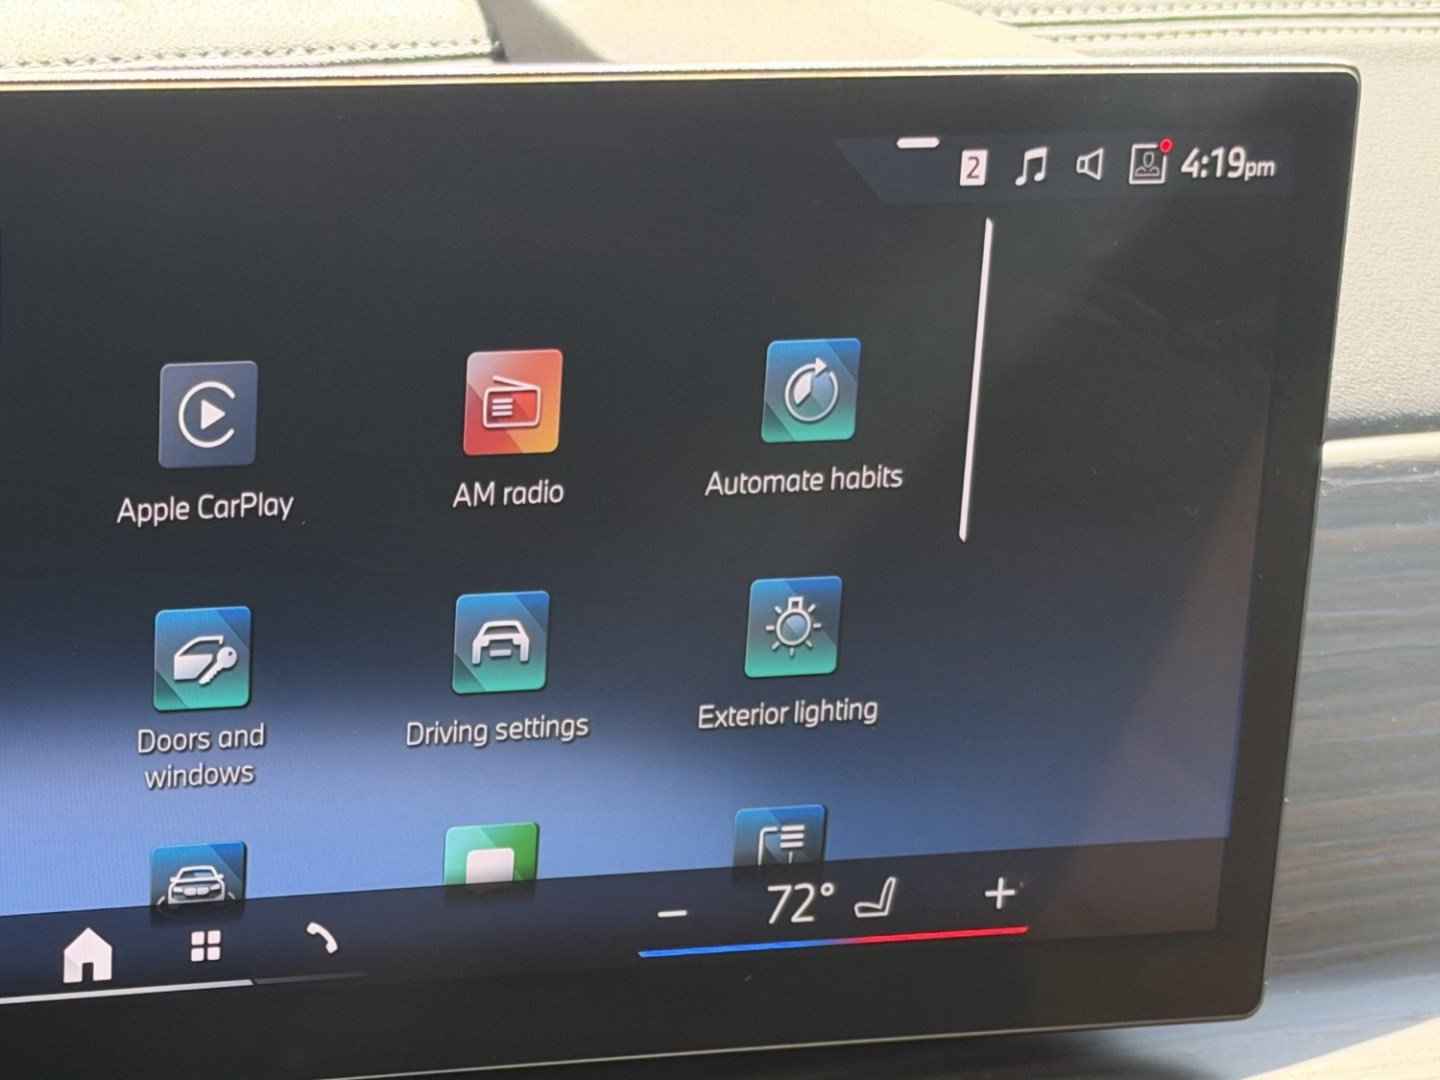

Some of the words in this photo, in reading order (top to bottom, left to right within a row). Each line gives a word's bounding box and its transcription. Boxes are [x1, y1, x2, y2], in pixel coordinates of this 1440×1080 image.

[1181, 146, 1276, 180] 4:19pm
[452, 481, 496, 509] AM
[503, 479, 565, 507] radio
[704, 468, 823, 497] Automate
[829, 464, 904, 493] habits
[116, 494, 190, 528] Apple
[197, 491, 295, 525] CarPlay
[405, 718, 488, 748] Driving
[495, 713, 590, 745] settings
[698, 702, 790, 730] Exterior
[794, 698, 879, 728] lighting
[136, 726, 212, 755] Doors
[218, 723, 266, 751] and
[145, 760, 255, 790] windows
[767, 881, 836, 925] 72°
